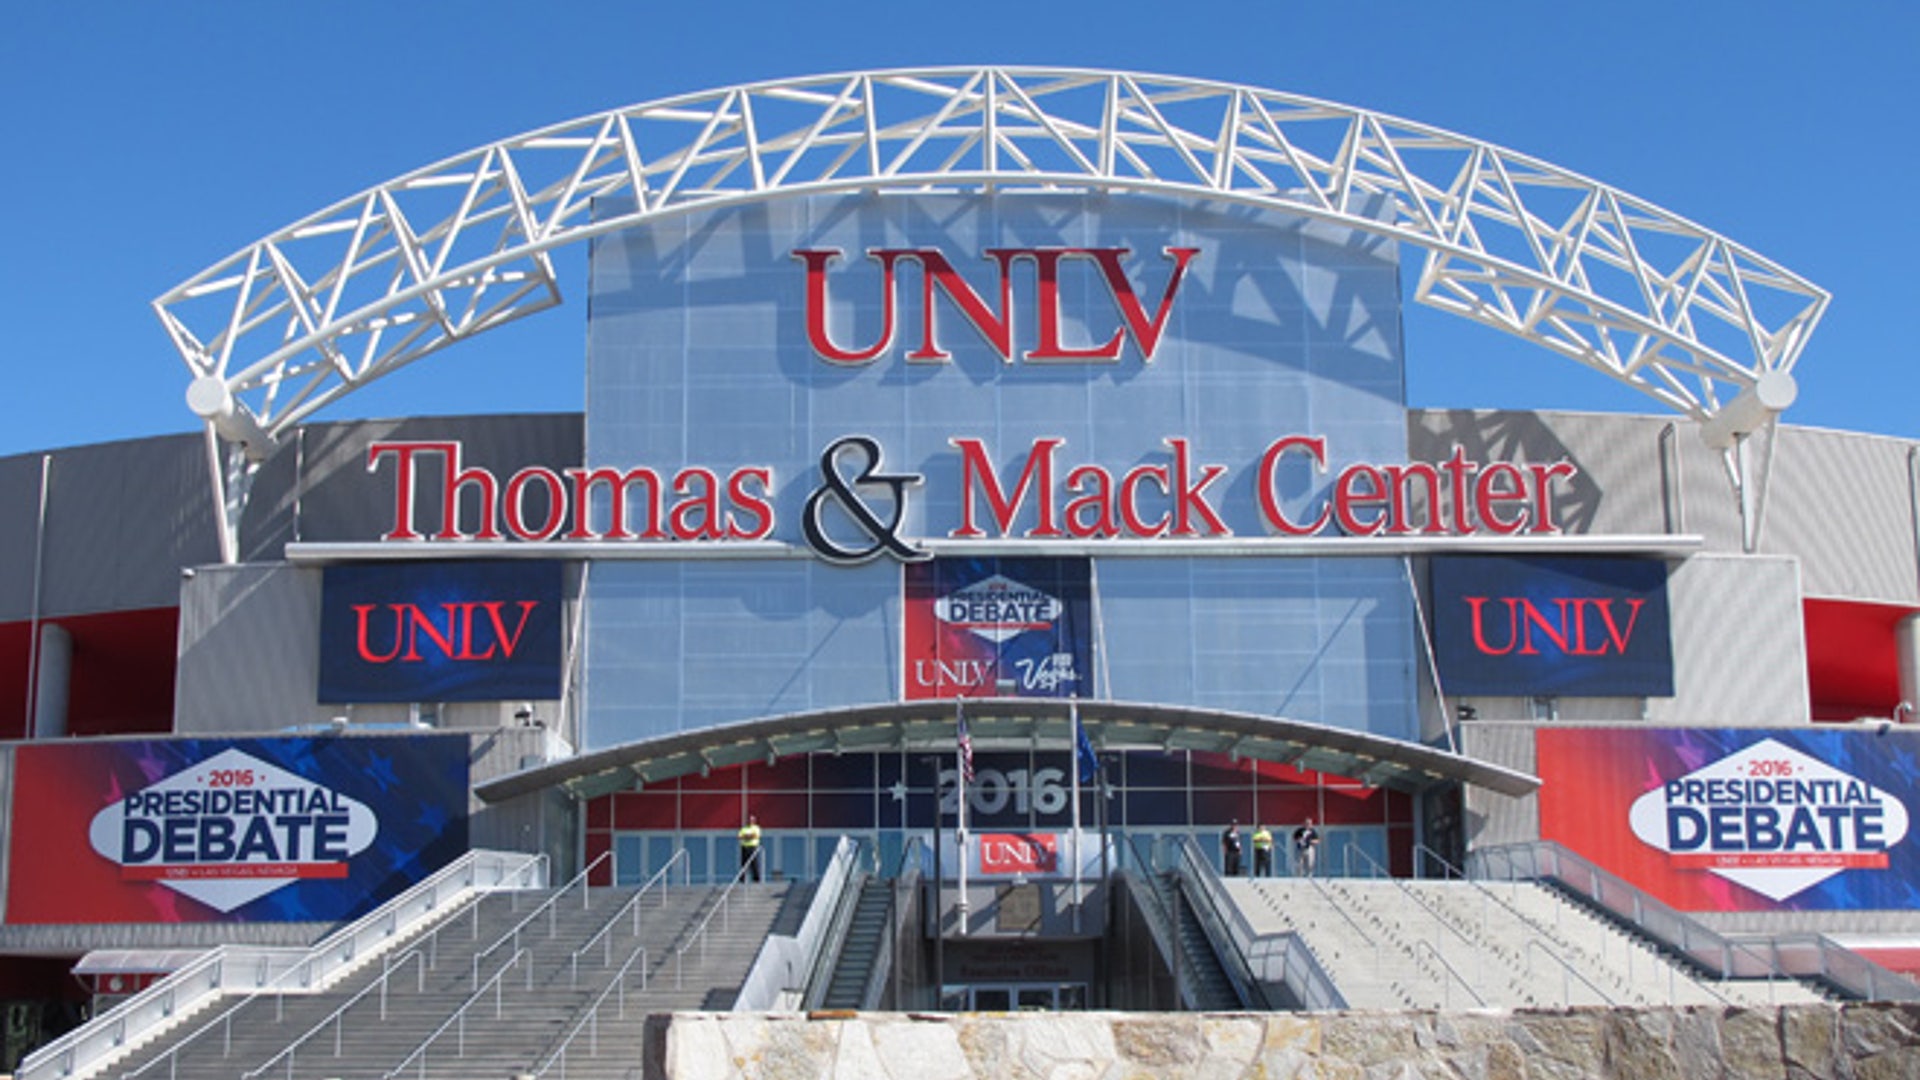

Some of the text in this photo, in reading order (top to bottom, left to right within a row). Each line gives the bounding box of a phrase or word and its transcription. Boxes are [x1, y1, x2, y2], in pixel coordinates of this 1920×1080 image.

[790, 246, 1201, 364] UNLV
[367, 435, 1578, 566] Thomas & Mack Center
[950, 603, 1051, 621] DEBATE
[1463, 596, 1646, 656] UNLV
[351, 601, 538, 663] UNLV
[915, 659, 993, 688] UNLV
[209, 769, 254, 788] 2016
[1748, 761, 1792, 777] 2016
[124, 789, 348, 818] PRESIDENTIAL
[938, 767, 1068, 815] 2016
[1666, 780, 1882, 805] PRESIDENTIAL
[122, 816, 349, 864] DEBATE
[1667, 806, 1886, 852] DEBATE
[982, 842, 1055, 865] UNLV
